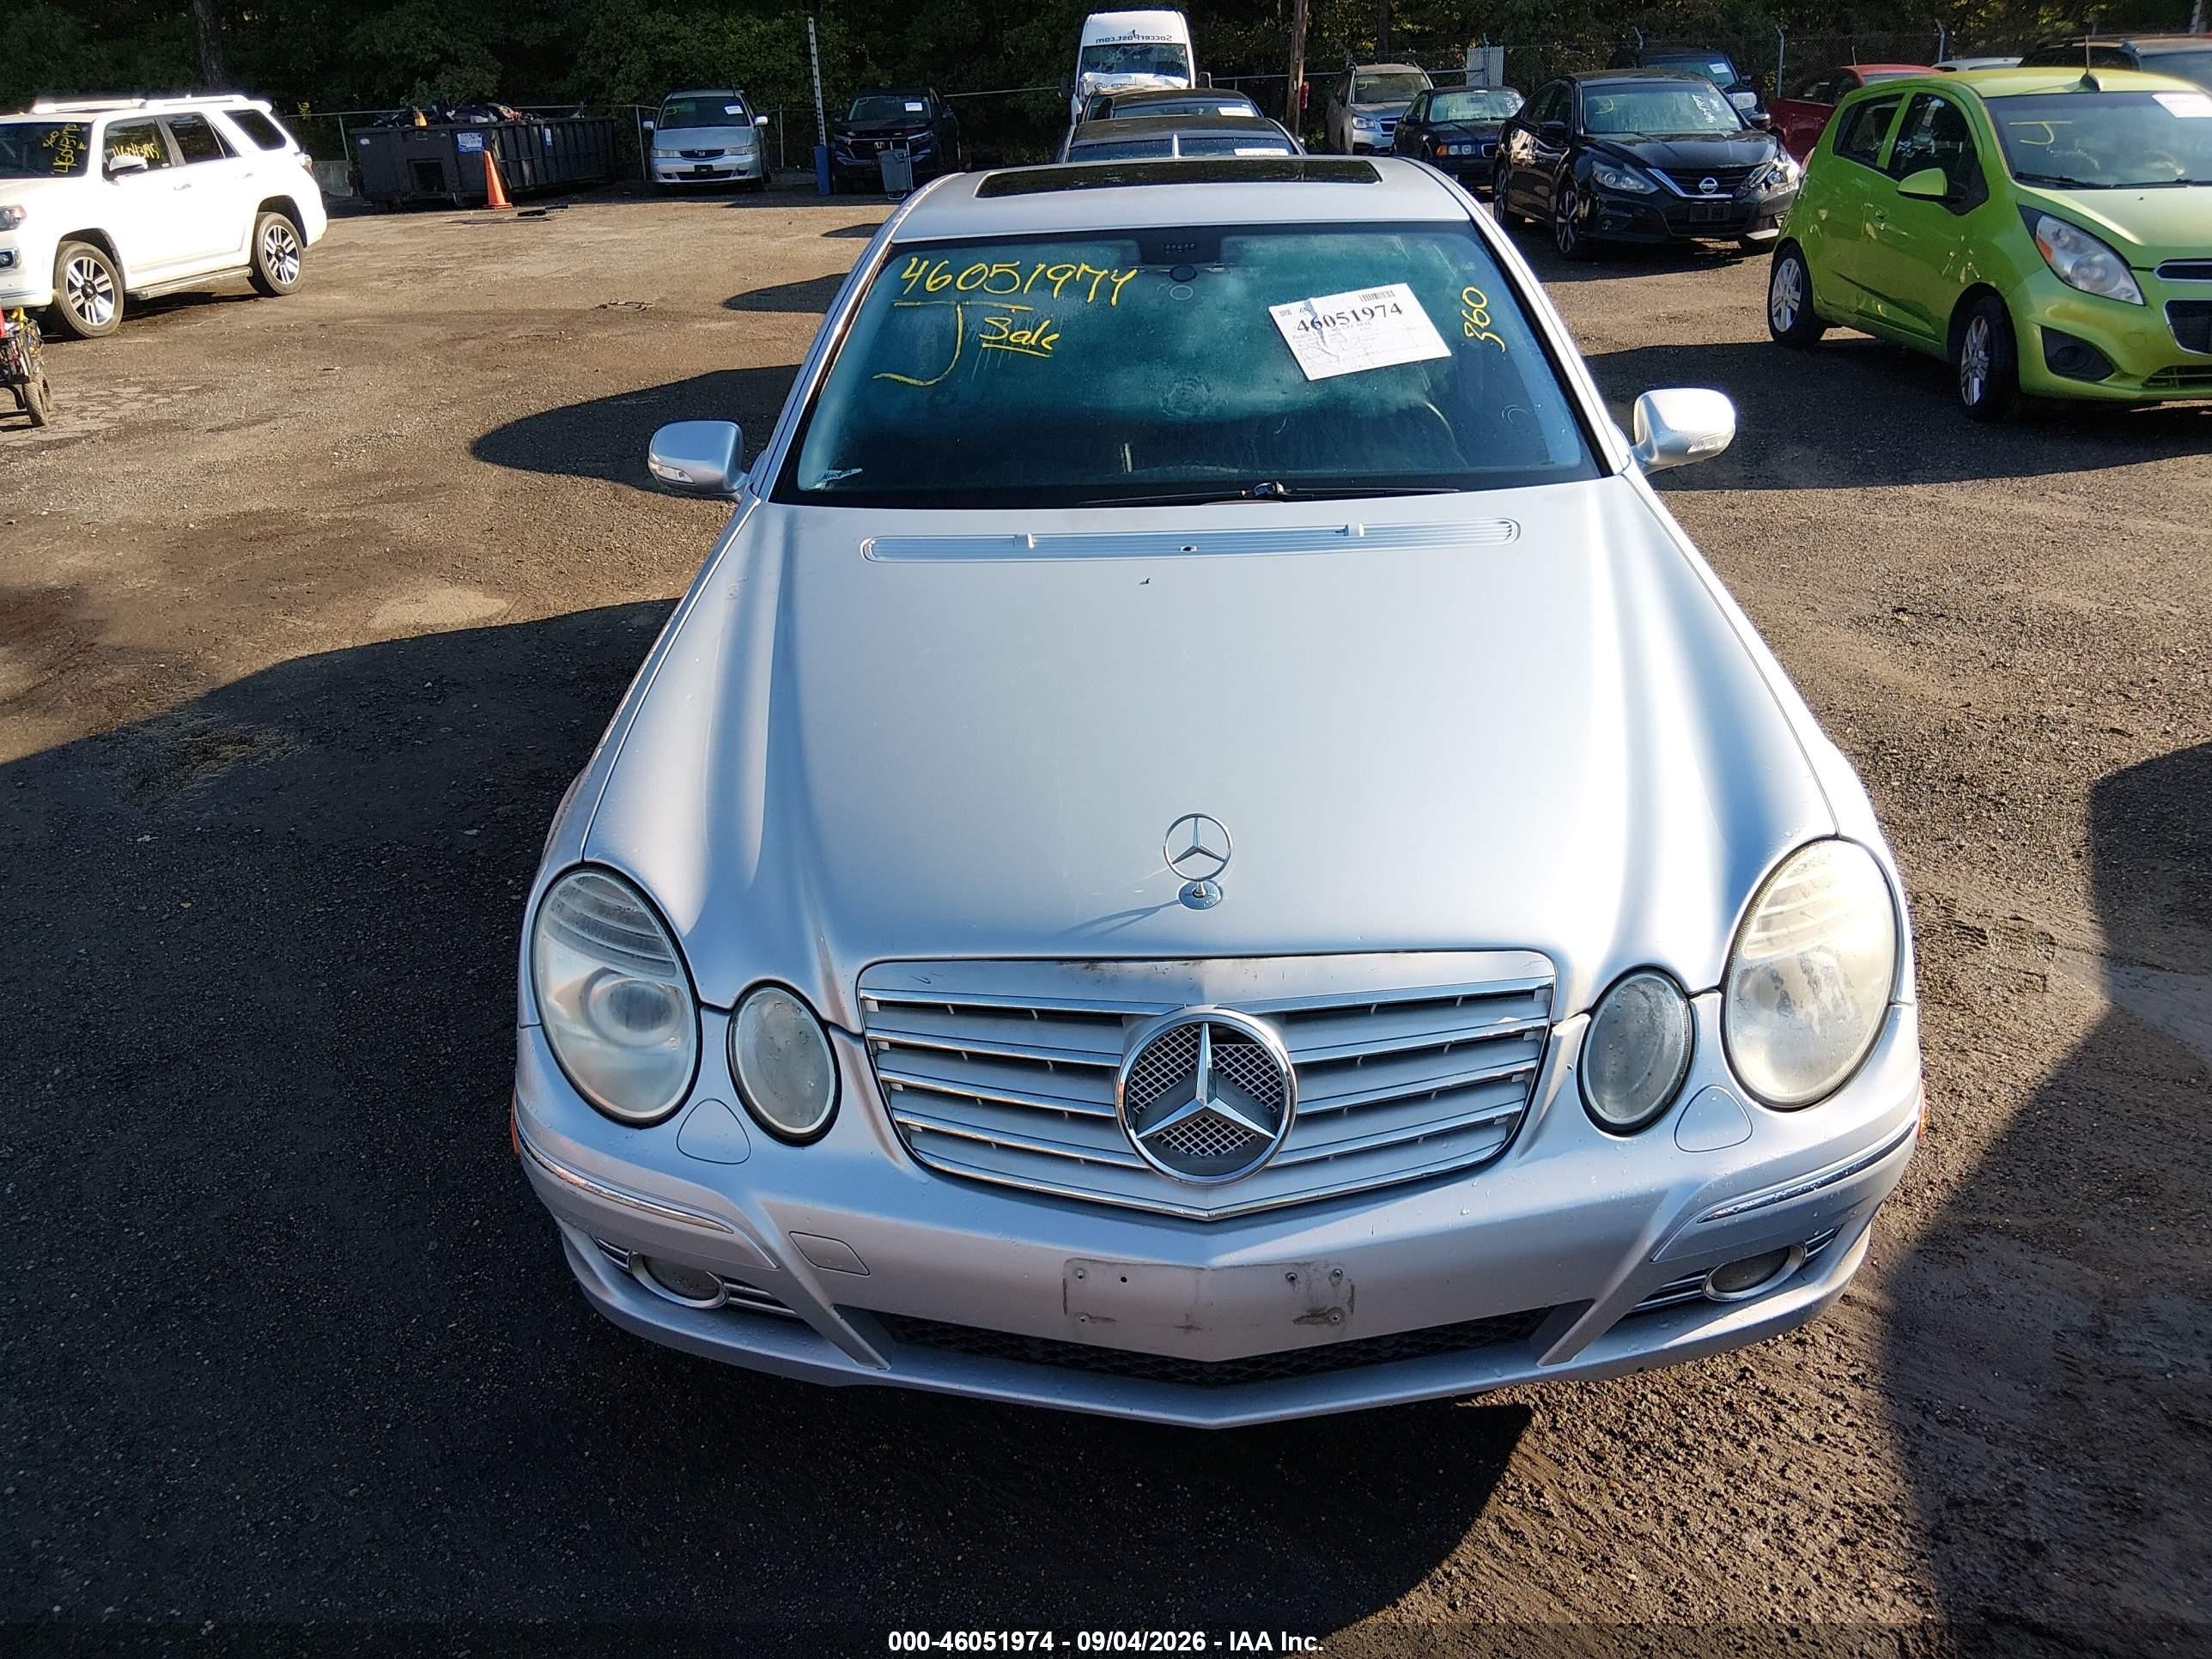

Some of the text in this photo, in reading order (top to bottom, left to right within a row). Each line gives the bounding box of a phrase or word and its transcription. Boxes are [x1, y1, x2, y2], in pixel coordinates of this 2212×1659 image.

[901, 257, 1138, 307] 46051974
[979, 316, 1060, 351] Sale
[1297, 302, 1403, 333] 46051974
[1462, 286, 1505, 354] 360
